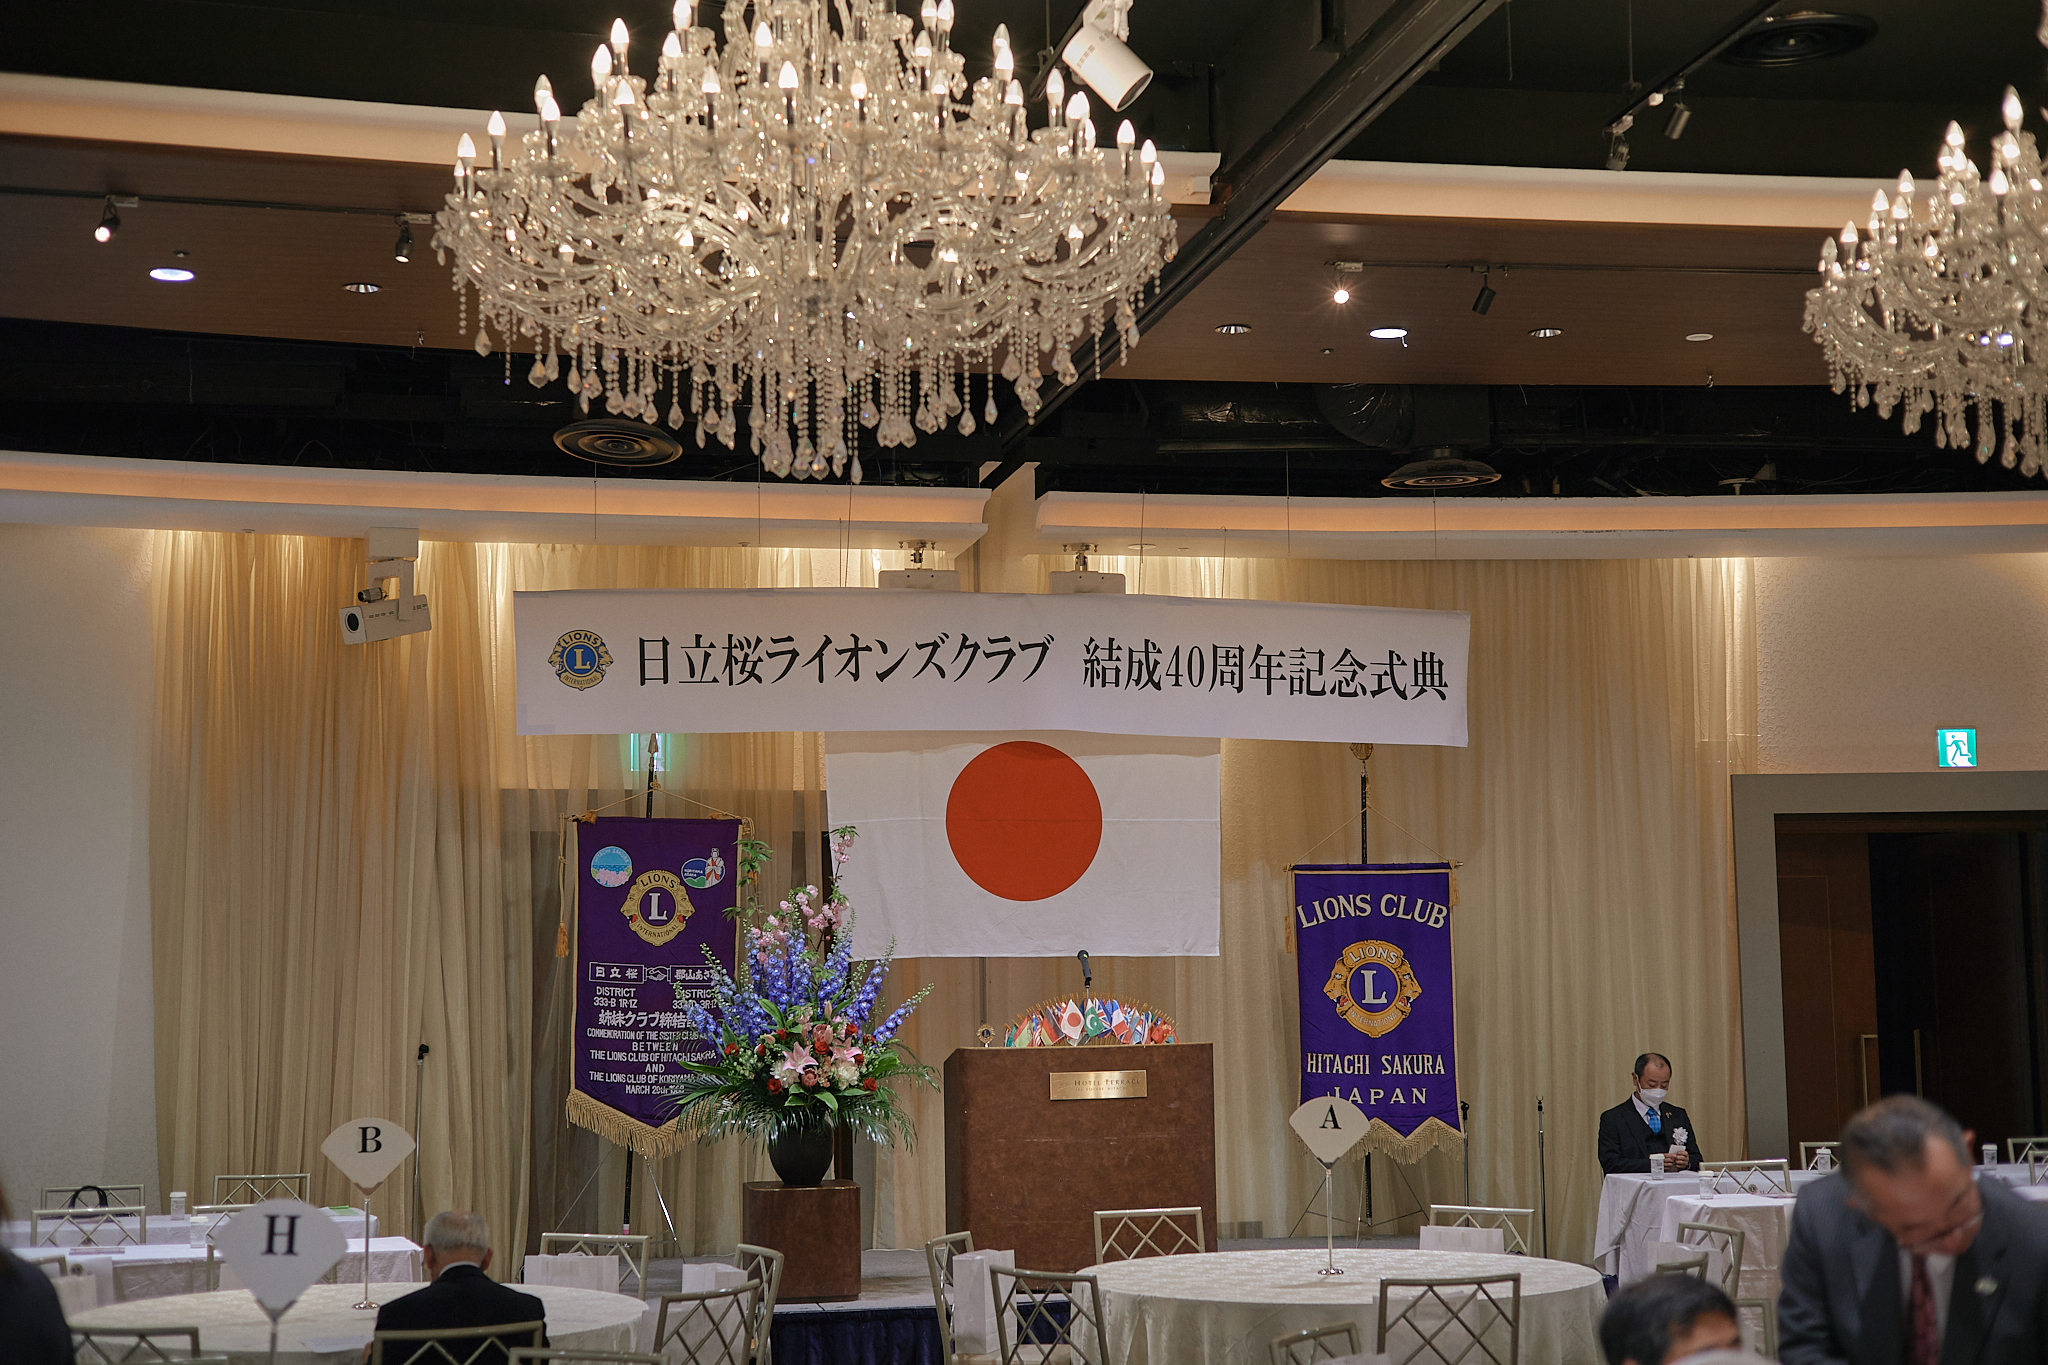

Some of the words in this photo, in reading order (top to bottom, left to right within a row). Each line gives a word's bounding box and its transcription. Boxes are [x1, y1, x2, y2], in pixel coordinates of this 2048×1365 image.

[562, 632, 599, 645] LIONS
[574, 648, 591, 670] L
[639, 632, 1056, 687] 日立桜ライオンズクラブ
[1082, 636, 1449, 701] 結成40周年記念式典
[562, 674, 600, 686] INTERNATIONAL
[640, 873, 677, 889] LIONS
[648, 892, 668, 921] L
[1297, 893, 1372, 928] LIONS
[1380, 893, 1448, 929] CLUB
[636, 923, 679, 938] INTERNATIONAL
[1349, 945, 1398, 964] LIONS
[595, 966, 639, 980] 日立桜
[596, 986, 637, 998] DISTRICT
[1361, 970, 1388, 1004] L
[593, 996, 617, 1008] 333-B
[1347, 1009, 1401, 1028] INTERNATIONAL
[636, 1031, 645, 1040] OF
[645, 1031, 659, 1040] THE
[632, 1041, 679, 1052] BETWEEN
[590, 1049, 606, 1060] THE
[606, 1051, 627, 1061] LIONS
[628, 1052, 649, 1062] CLUB
[649, 1053, 660, 1063] OF
[660, 1053, 690, 1063] HITACHI
[1306, 1052, 1371, 1075] HITACHI
[1381, 1053, 1446, 1075] SAKURA
[644, 1063, 665, 1073] AND
[589, 1070, 604, 1082] THE
[605, 1072, 626, 1083] LIONS
[626, 1073, 647, 1084] CLUB
[647, 1074, 658, 1084] OF
[625, 1084, 651, 1095] MARCH
[1319, 1104, 1342, 1130] A
[358, 1126, 383, 1154] B
[261, 1213, 302, 1257] H
